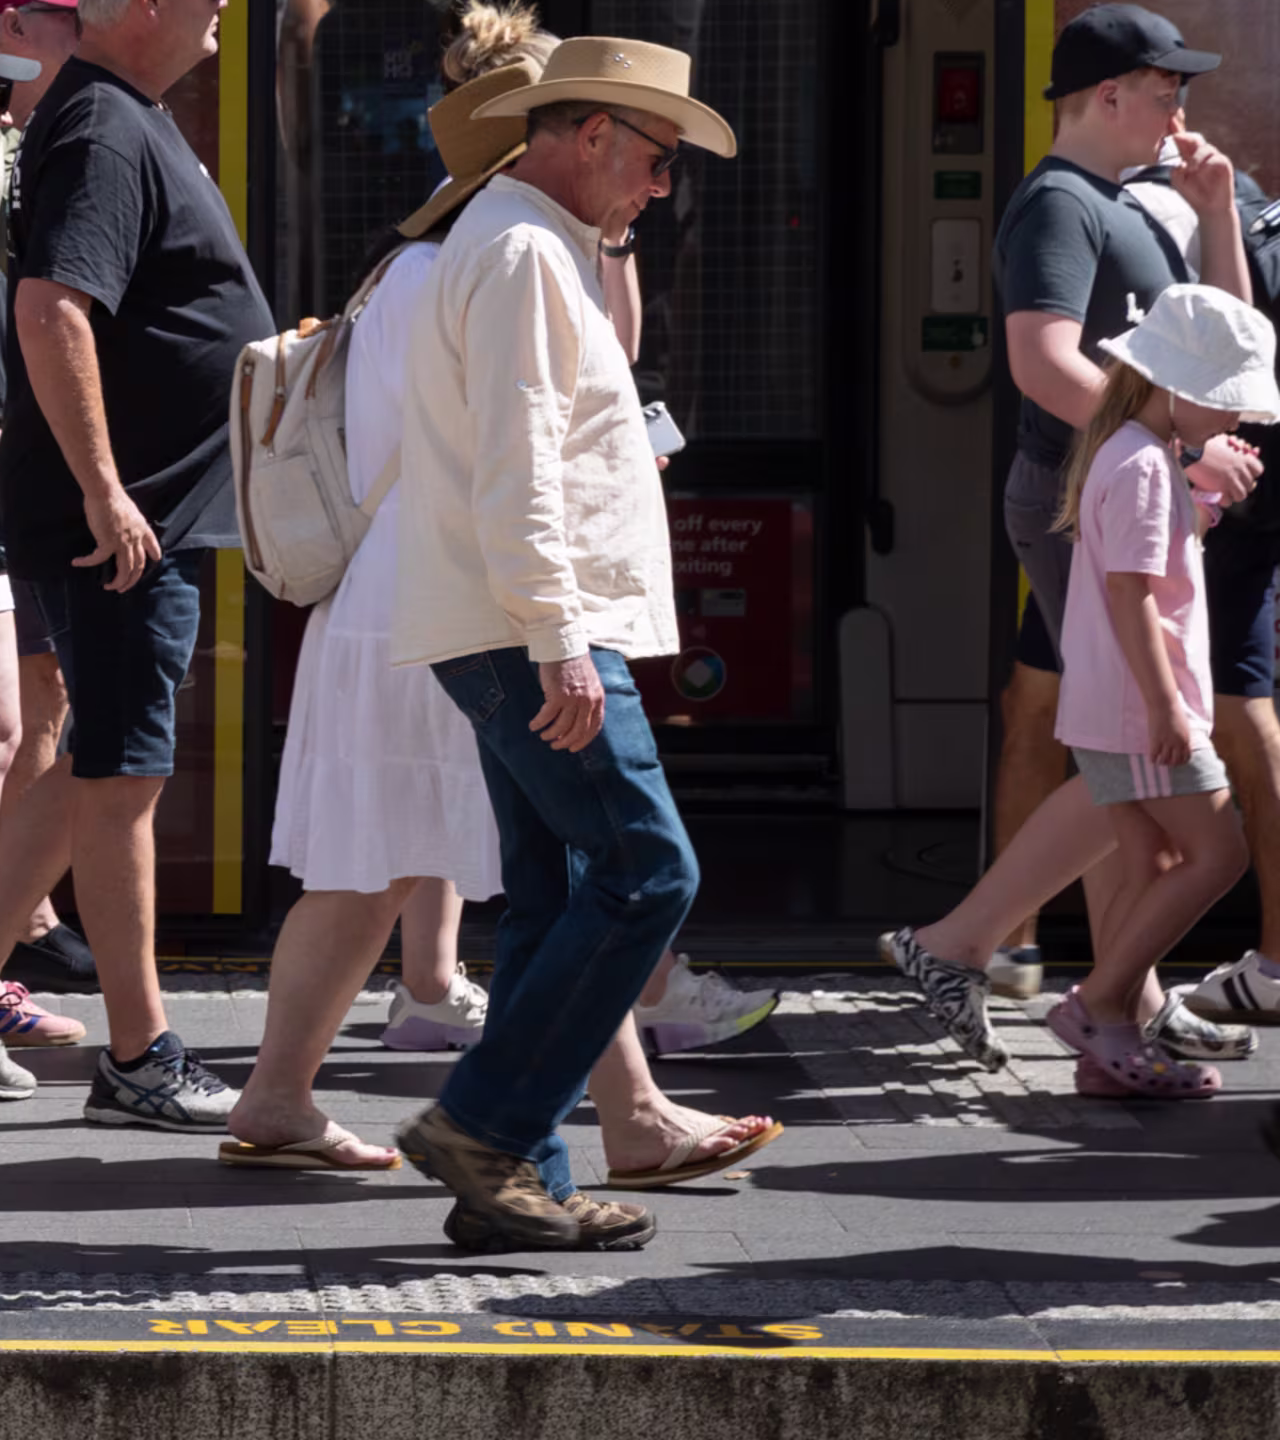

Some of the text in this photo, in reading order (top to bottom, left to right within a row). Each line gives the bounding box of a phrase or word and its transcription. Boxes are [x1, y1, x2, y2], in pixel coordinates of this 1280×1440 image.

[673, 514, 762, 536] off every
[700, 536, 749, 552] after
[149, 1317, 824, 1341] STAND CLEAR
